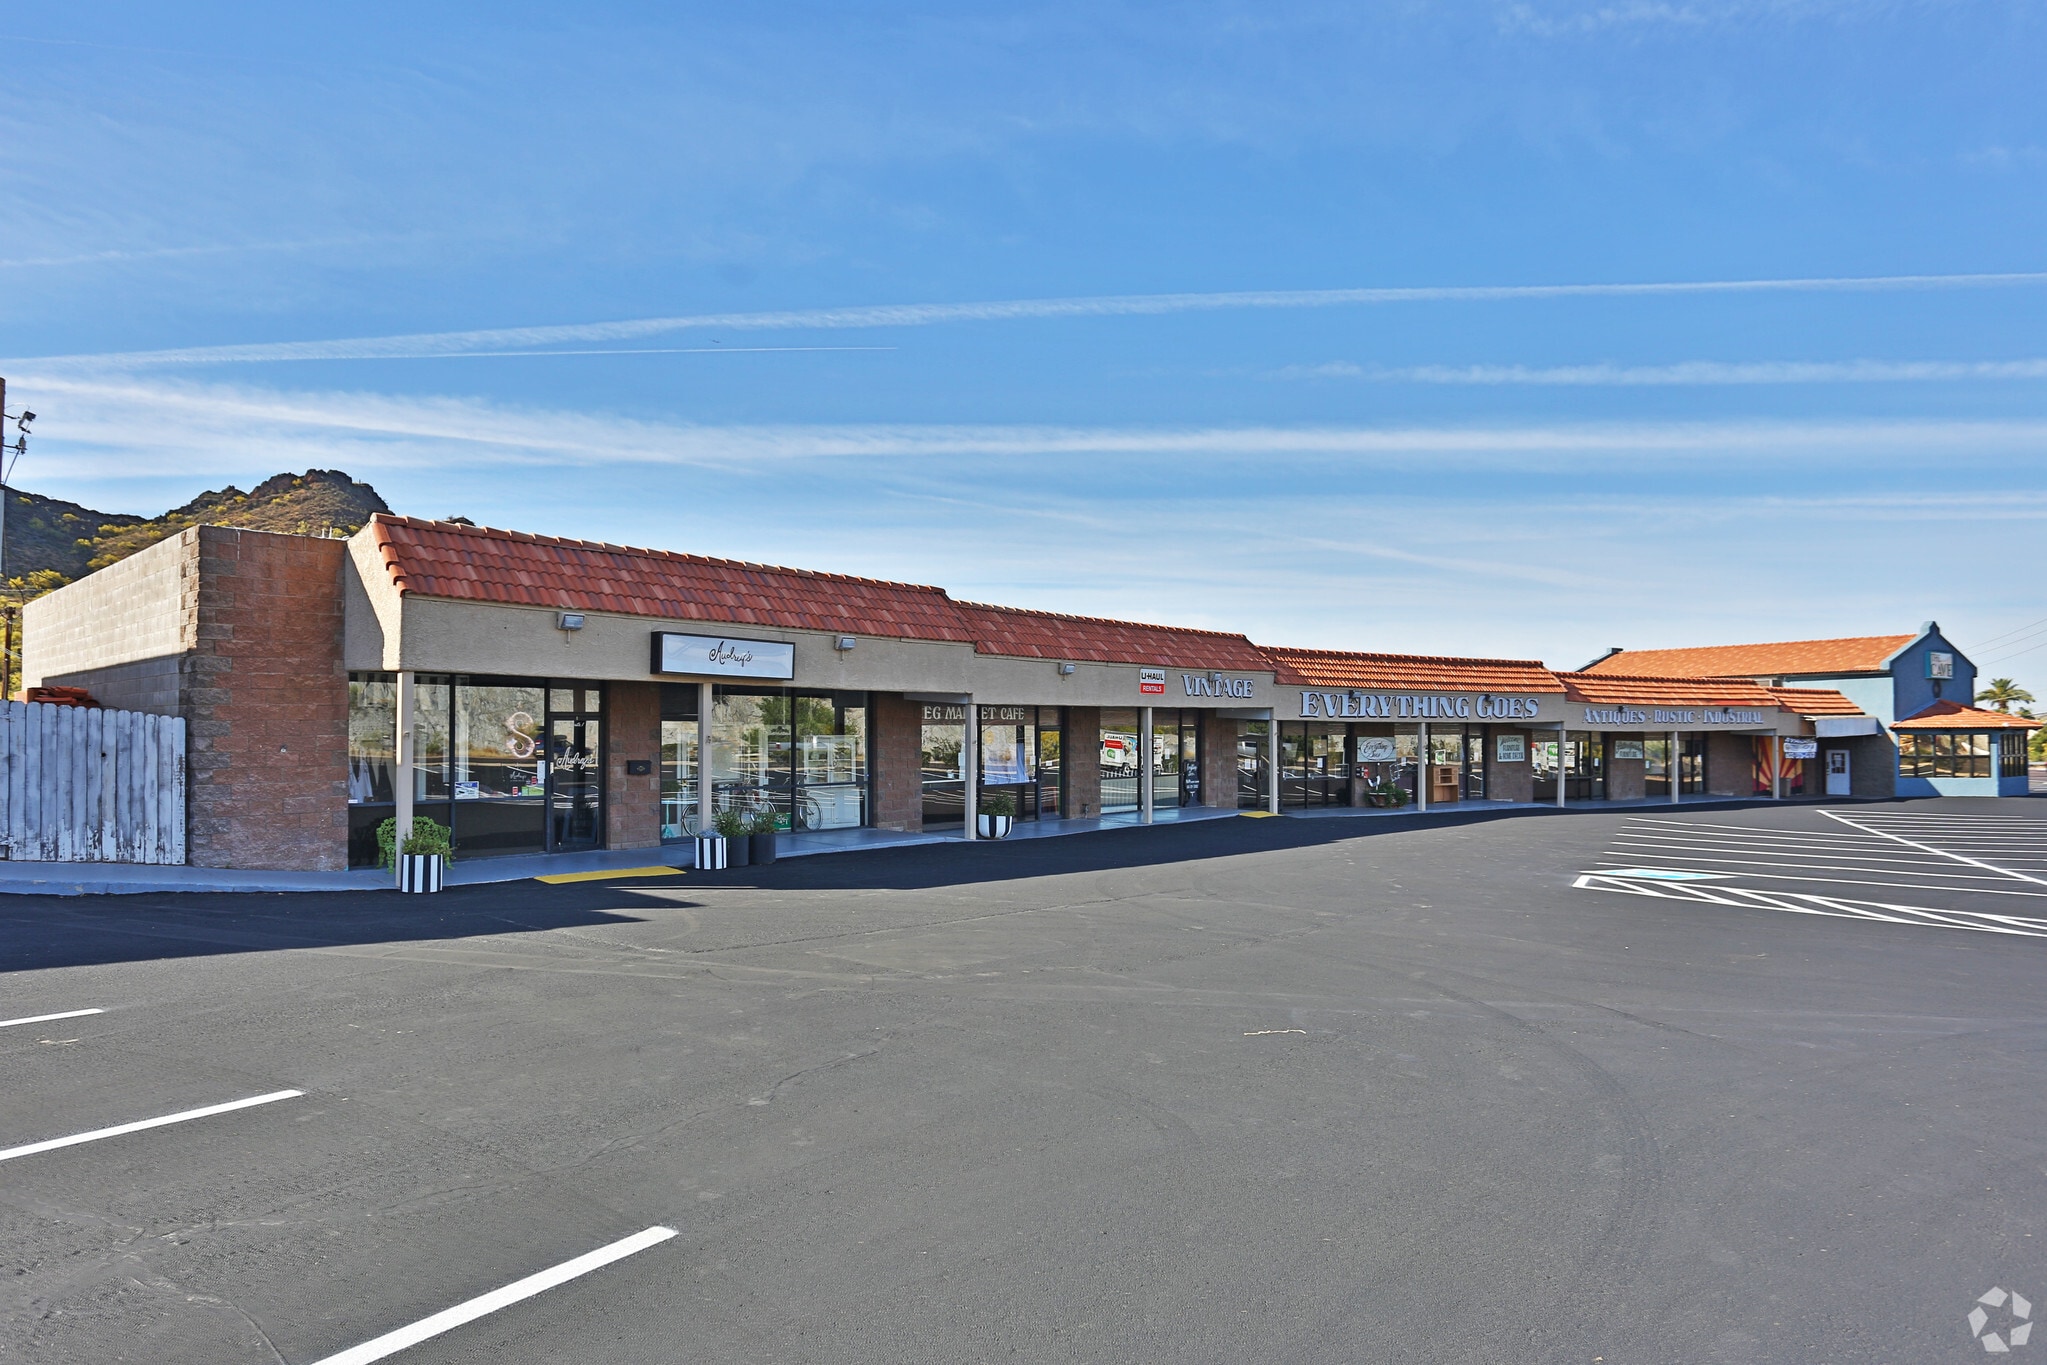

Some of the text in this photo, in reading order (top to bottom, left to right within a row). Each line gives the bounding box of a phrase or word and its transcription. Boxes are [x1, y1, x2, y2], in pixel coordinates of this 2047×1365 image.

[709, 640, 753, 668] Audrey's
[1141, 672, 1164, 681] U-HAUL
[1930, 663, 1952, 677] CAVE
[1181, 674, 1254, 699] VINTAGE
[922, 706, 1025, 720] EG MAET CAFE
[1299, 691, 1539, 720] EVERYTHING GOES
[1582, 707, 1764, 727] ANTIQUES RUSTIC INDUSTRIAL
[556, 746, 595, 770] Audrey's
